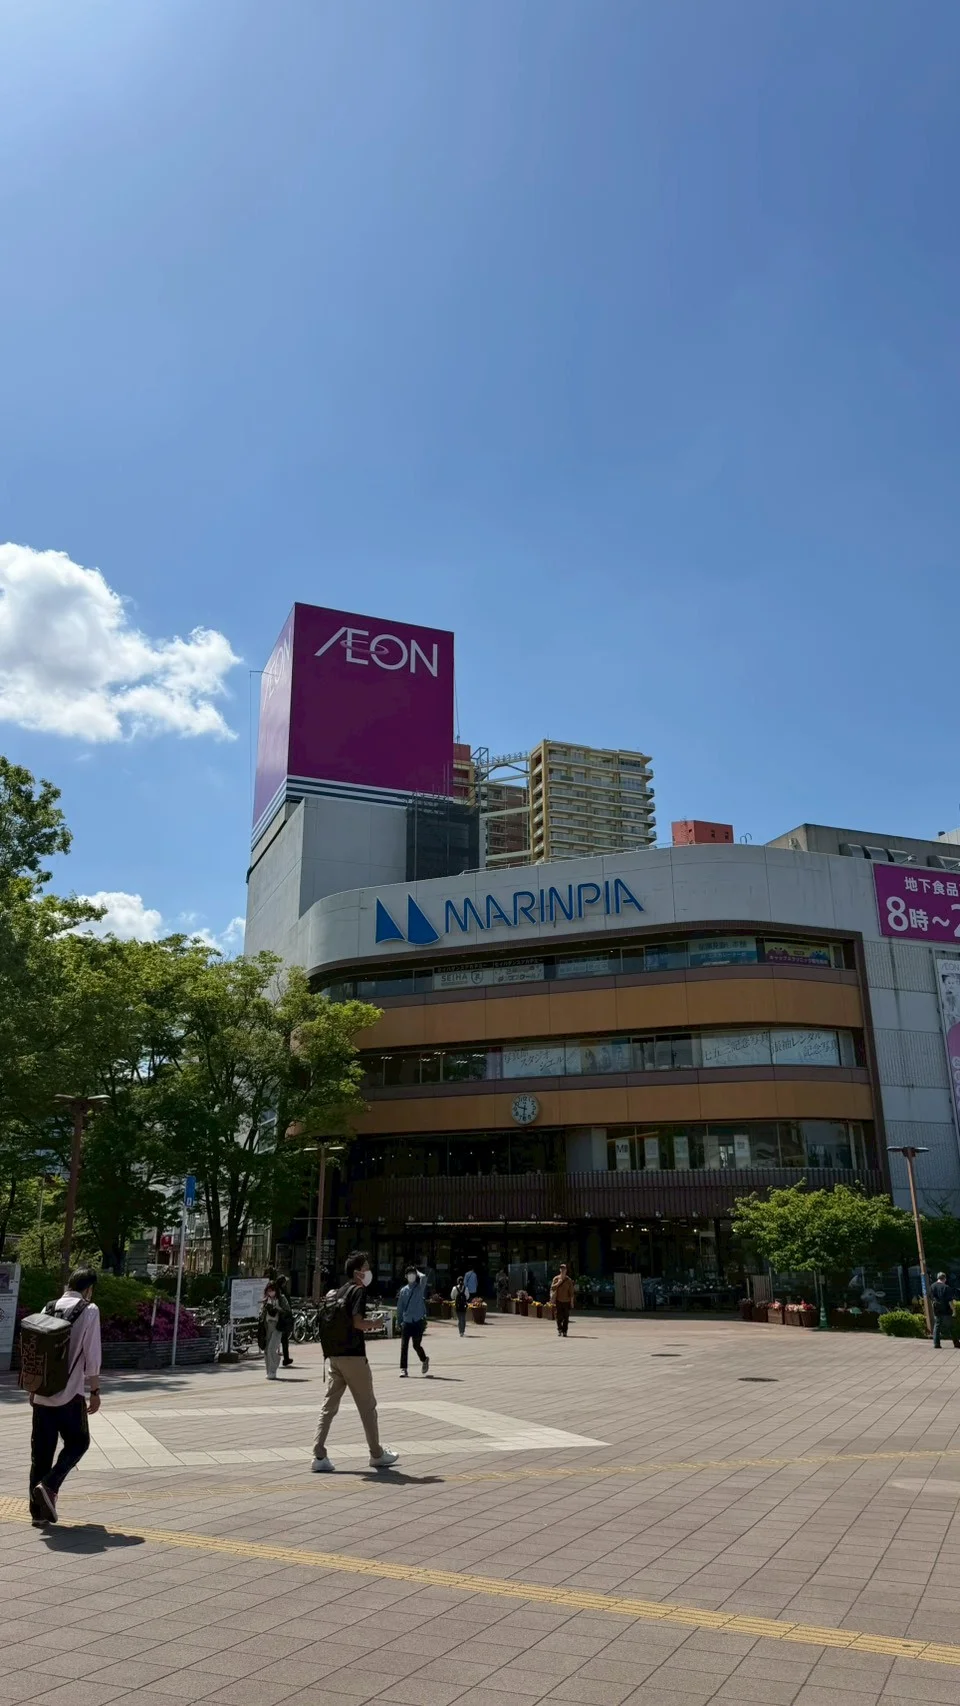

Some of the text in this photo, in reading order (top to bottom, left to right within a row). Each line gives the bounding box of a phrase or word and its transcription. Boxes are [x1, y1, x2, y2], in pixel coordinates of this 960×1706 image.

[904, 876, 960, 897] 地下食品
[444, 878, 645, 934] MARINPIA
[441, 972, 468, 982] SEIHA
